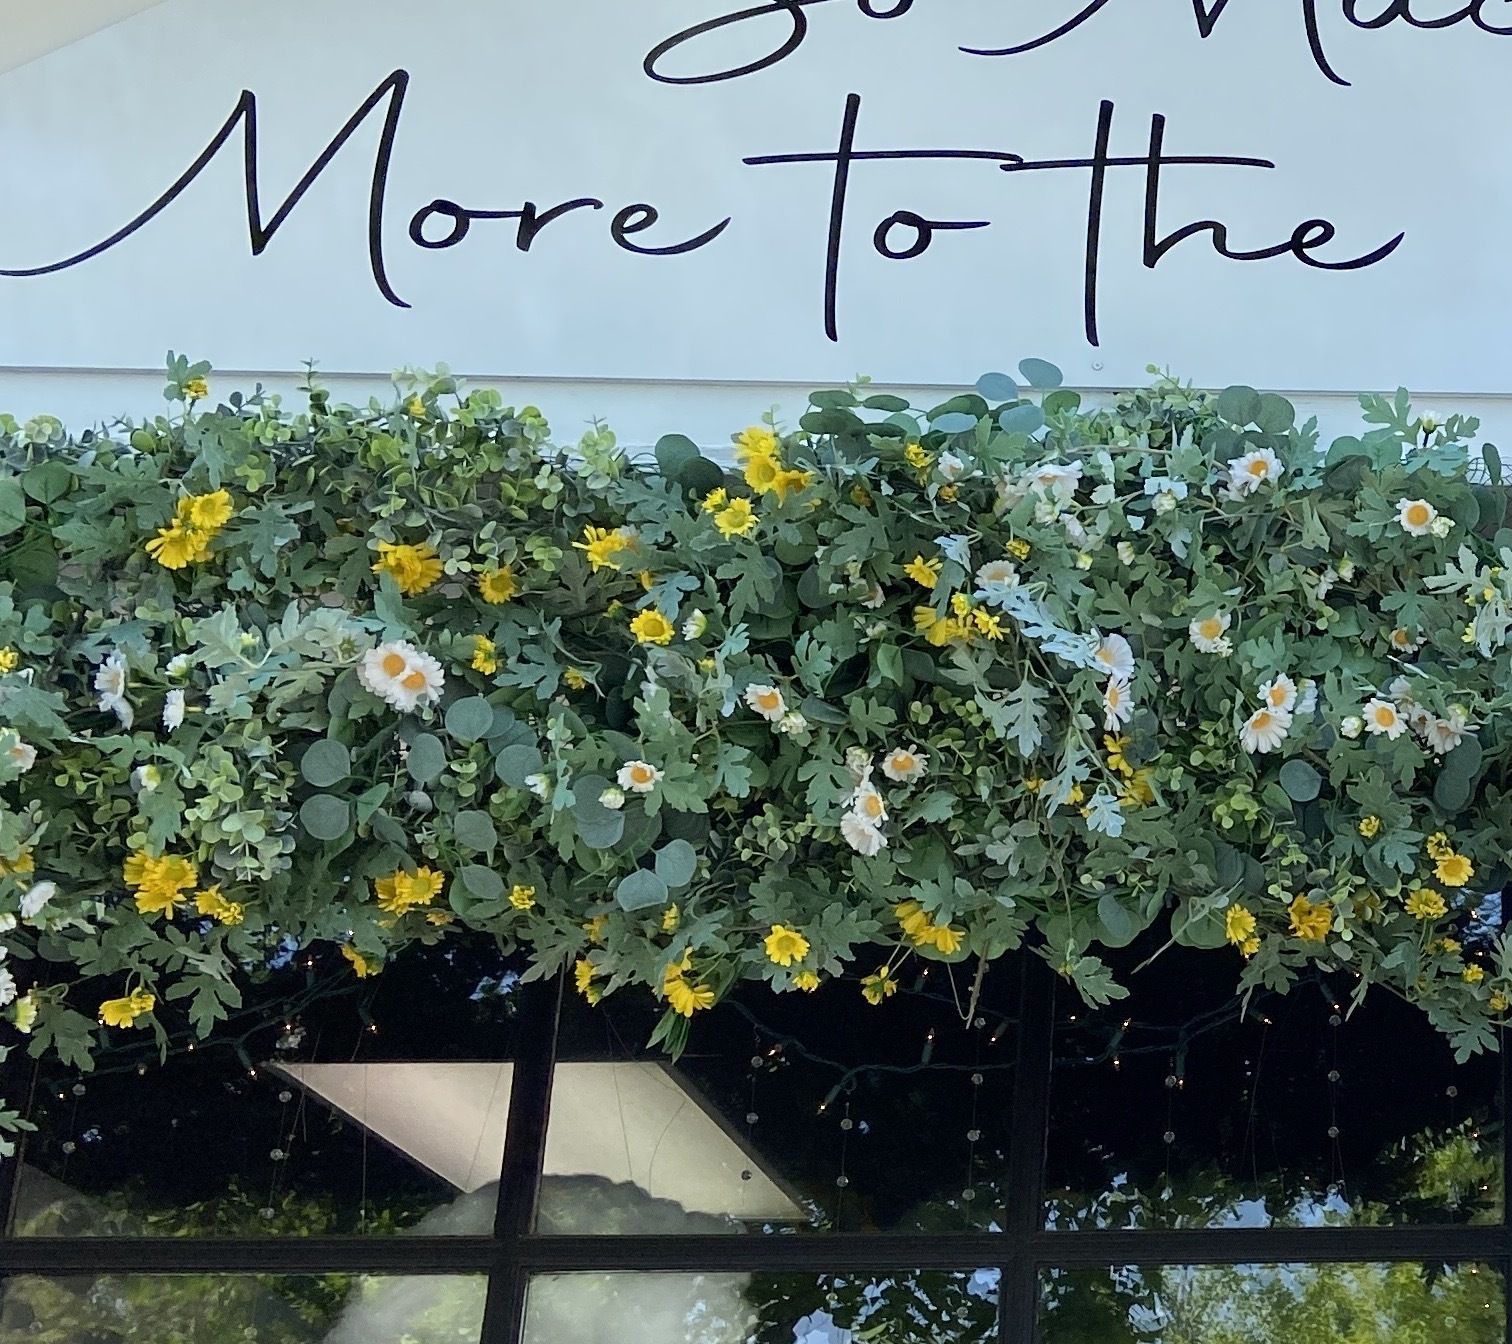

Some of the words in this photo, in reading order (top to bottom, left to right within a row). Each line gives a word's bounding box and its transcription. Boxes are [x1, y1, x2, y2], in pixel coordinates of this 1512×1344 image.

[0, 70, 730, 308] More
[743, 94, 1023, 343] to
[1000, 99, 1404, 346] the
